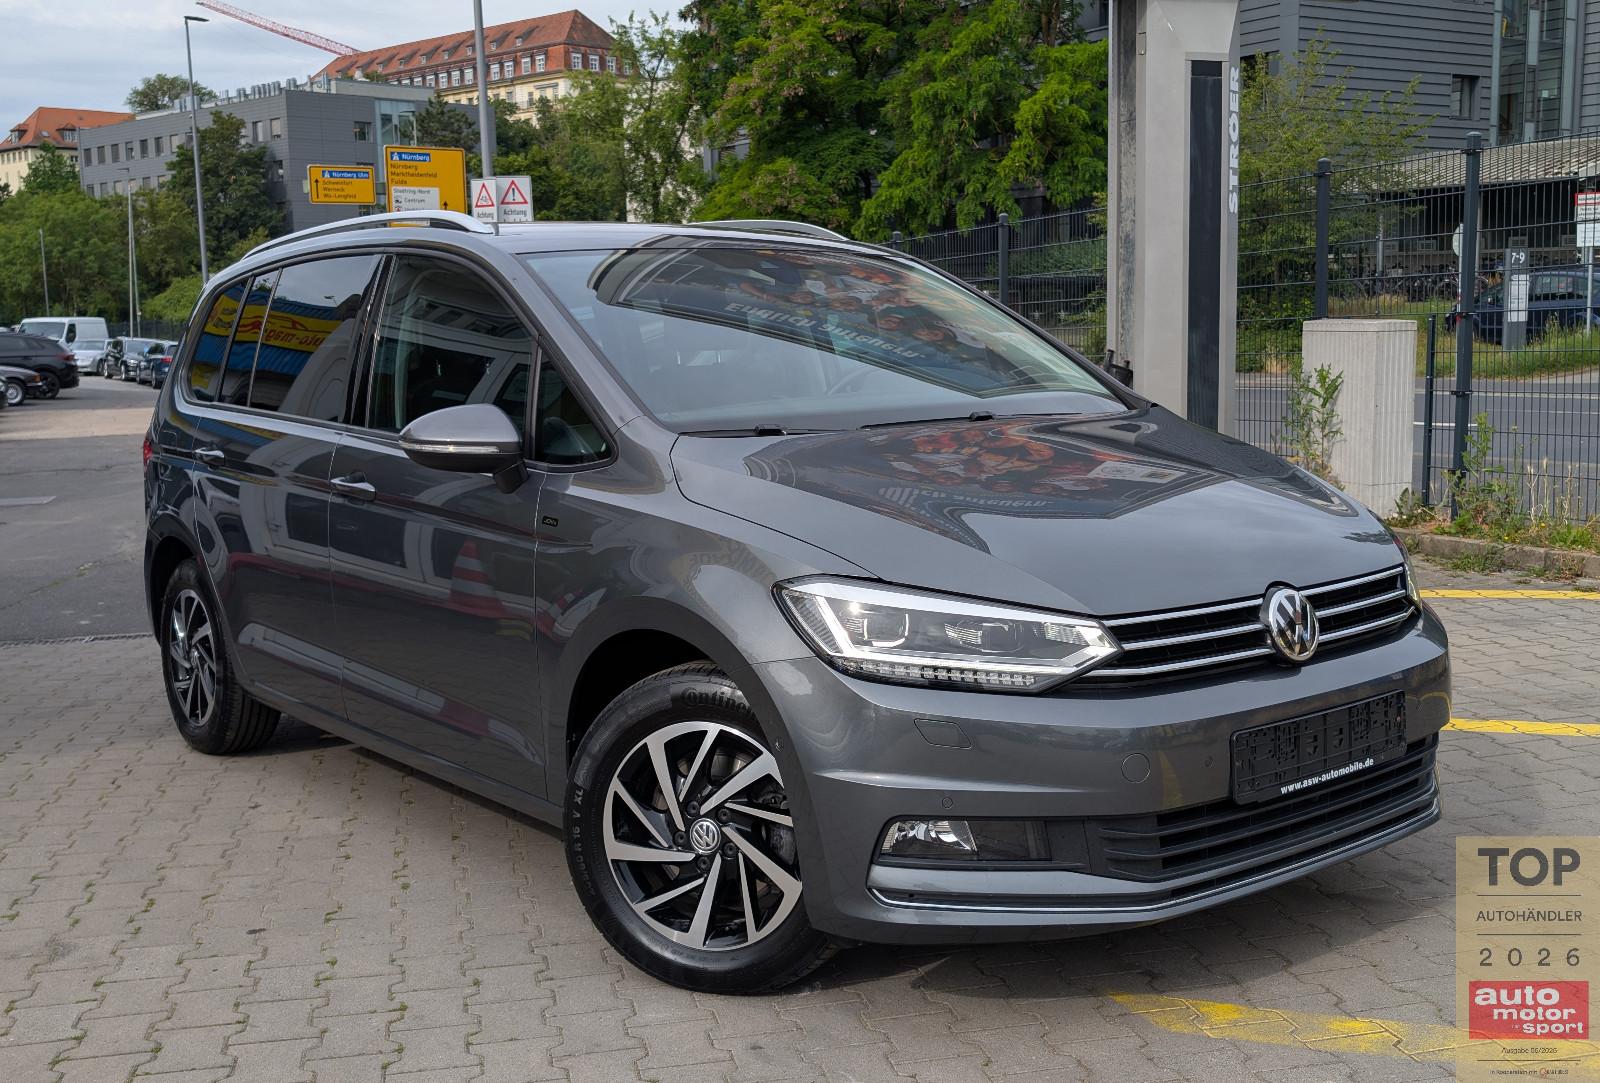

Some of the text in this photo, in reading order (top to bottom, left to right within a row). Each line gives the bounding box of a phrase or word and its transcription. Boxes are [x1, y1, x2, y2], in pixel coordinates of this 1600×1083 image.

[1228, 66, 1239, 214] STRÖER
[402, 153, 430, 162] Nürnberg
[503, 209, 528, 217] Achtung
[1511, 252, 1525, 264] 7-9
[1280, 757, 1374, 794] www.asw-automobile.de
